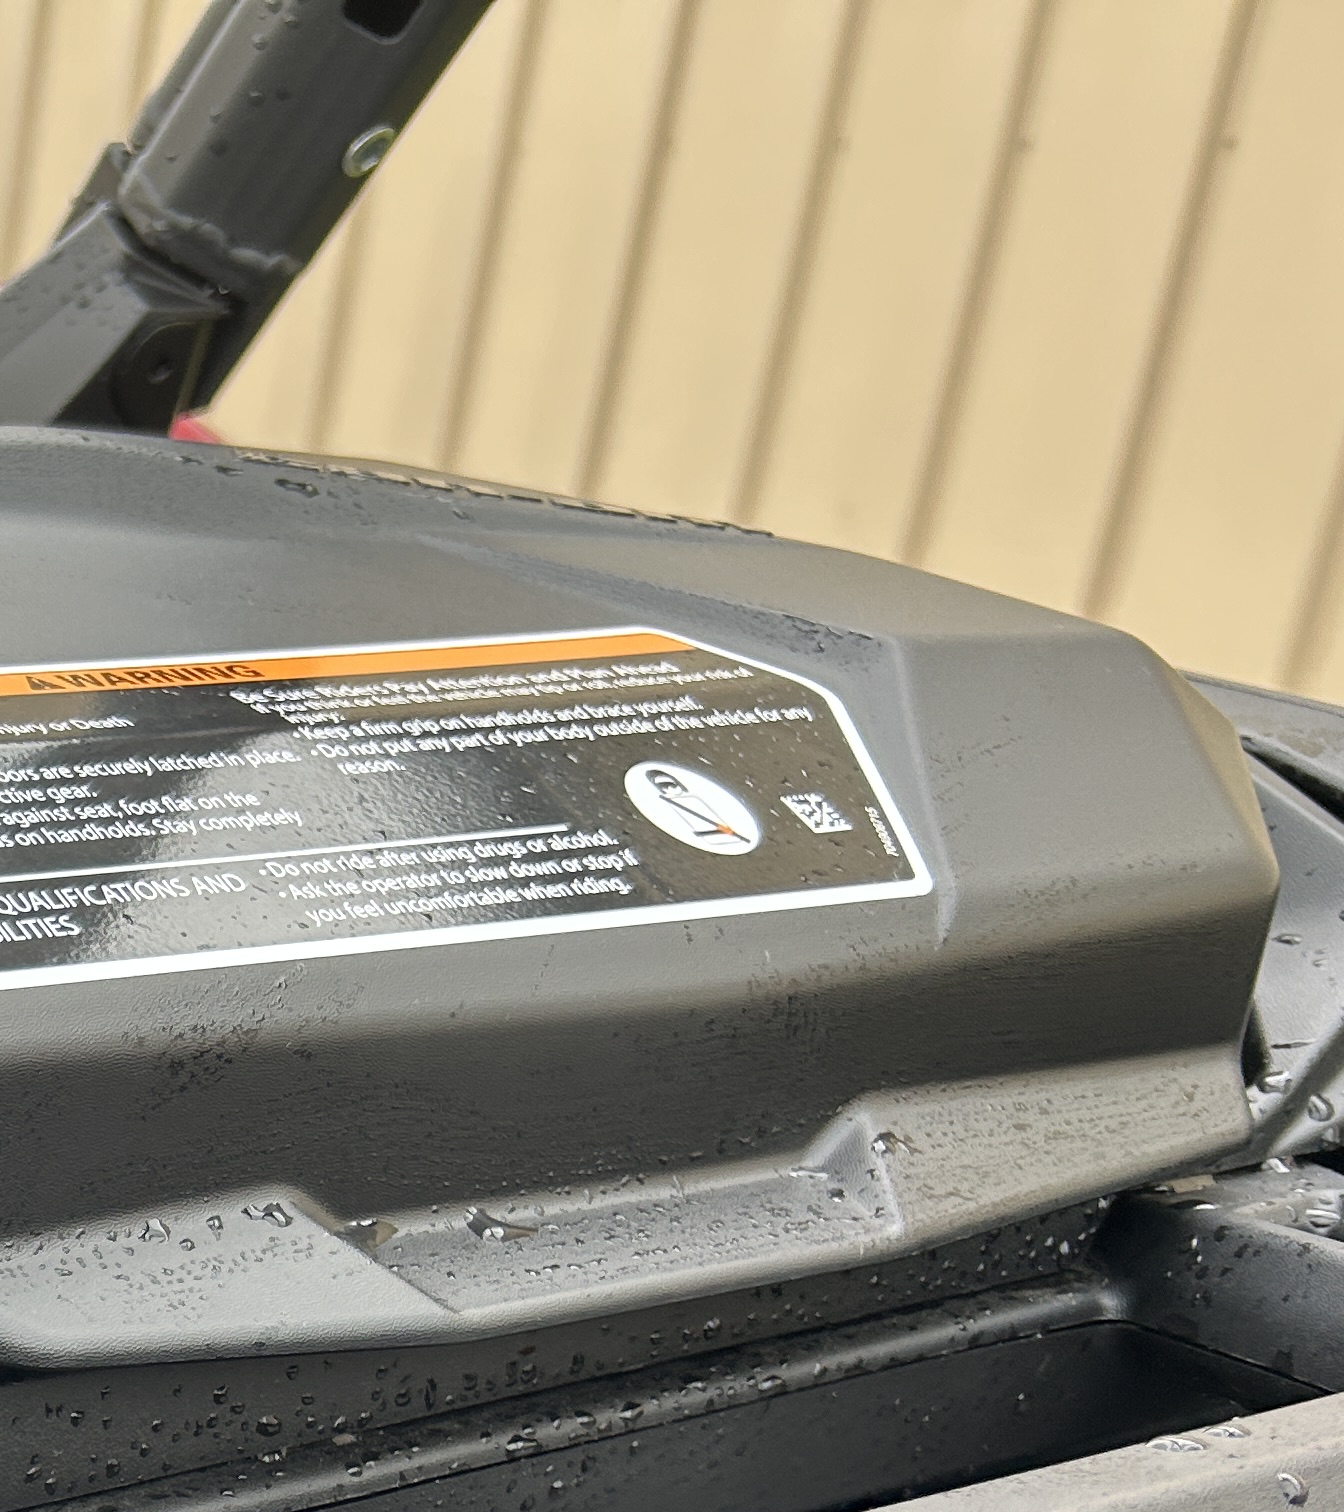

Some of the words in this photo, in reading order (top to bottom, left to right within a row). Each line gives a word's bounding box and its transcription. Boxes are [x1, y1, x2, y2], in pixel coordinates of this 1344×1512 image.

[57, 664, 265, 689] WARNING
[39, 764, 75, 780] are
[72, 756, 154, 778] securely
[151, 751, 225, 772] latched
[220, 751, 246, 767] in
[242, 748, 301, 769] place.
[265, 861, 300, 878] Do
[300, 857, 339, 875] not
[337, 853, 377, 872] ride
[372, 849, 422, 868] after
[422, 842, 478, 869] using
[473, 840, 529, 862] drugs
[525, 838, 549, 853] or
[546, 829, 620, 851] alcohol.
[288, 881, 327, 900] Ask
[324, 874, 362, 897] the
[361, 871, 443, 896] operator
[437, 866, 466, 885] to
[463, 865, 509, 883] slow
[507, 859, 563, 878] down
[560, 857, 585, 873] or
[581, 853, 625, 872] stop
[617, 847, 640, 867] if
[191, 873, 247, 896] AND
[305, 904, 347, 928] you
[343, 899, 385, 919] feel
[383, 885, 523, 914] uncomfortable
[516, 881, 575, 901] when
[570, 875, 634, 896] riding.
